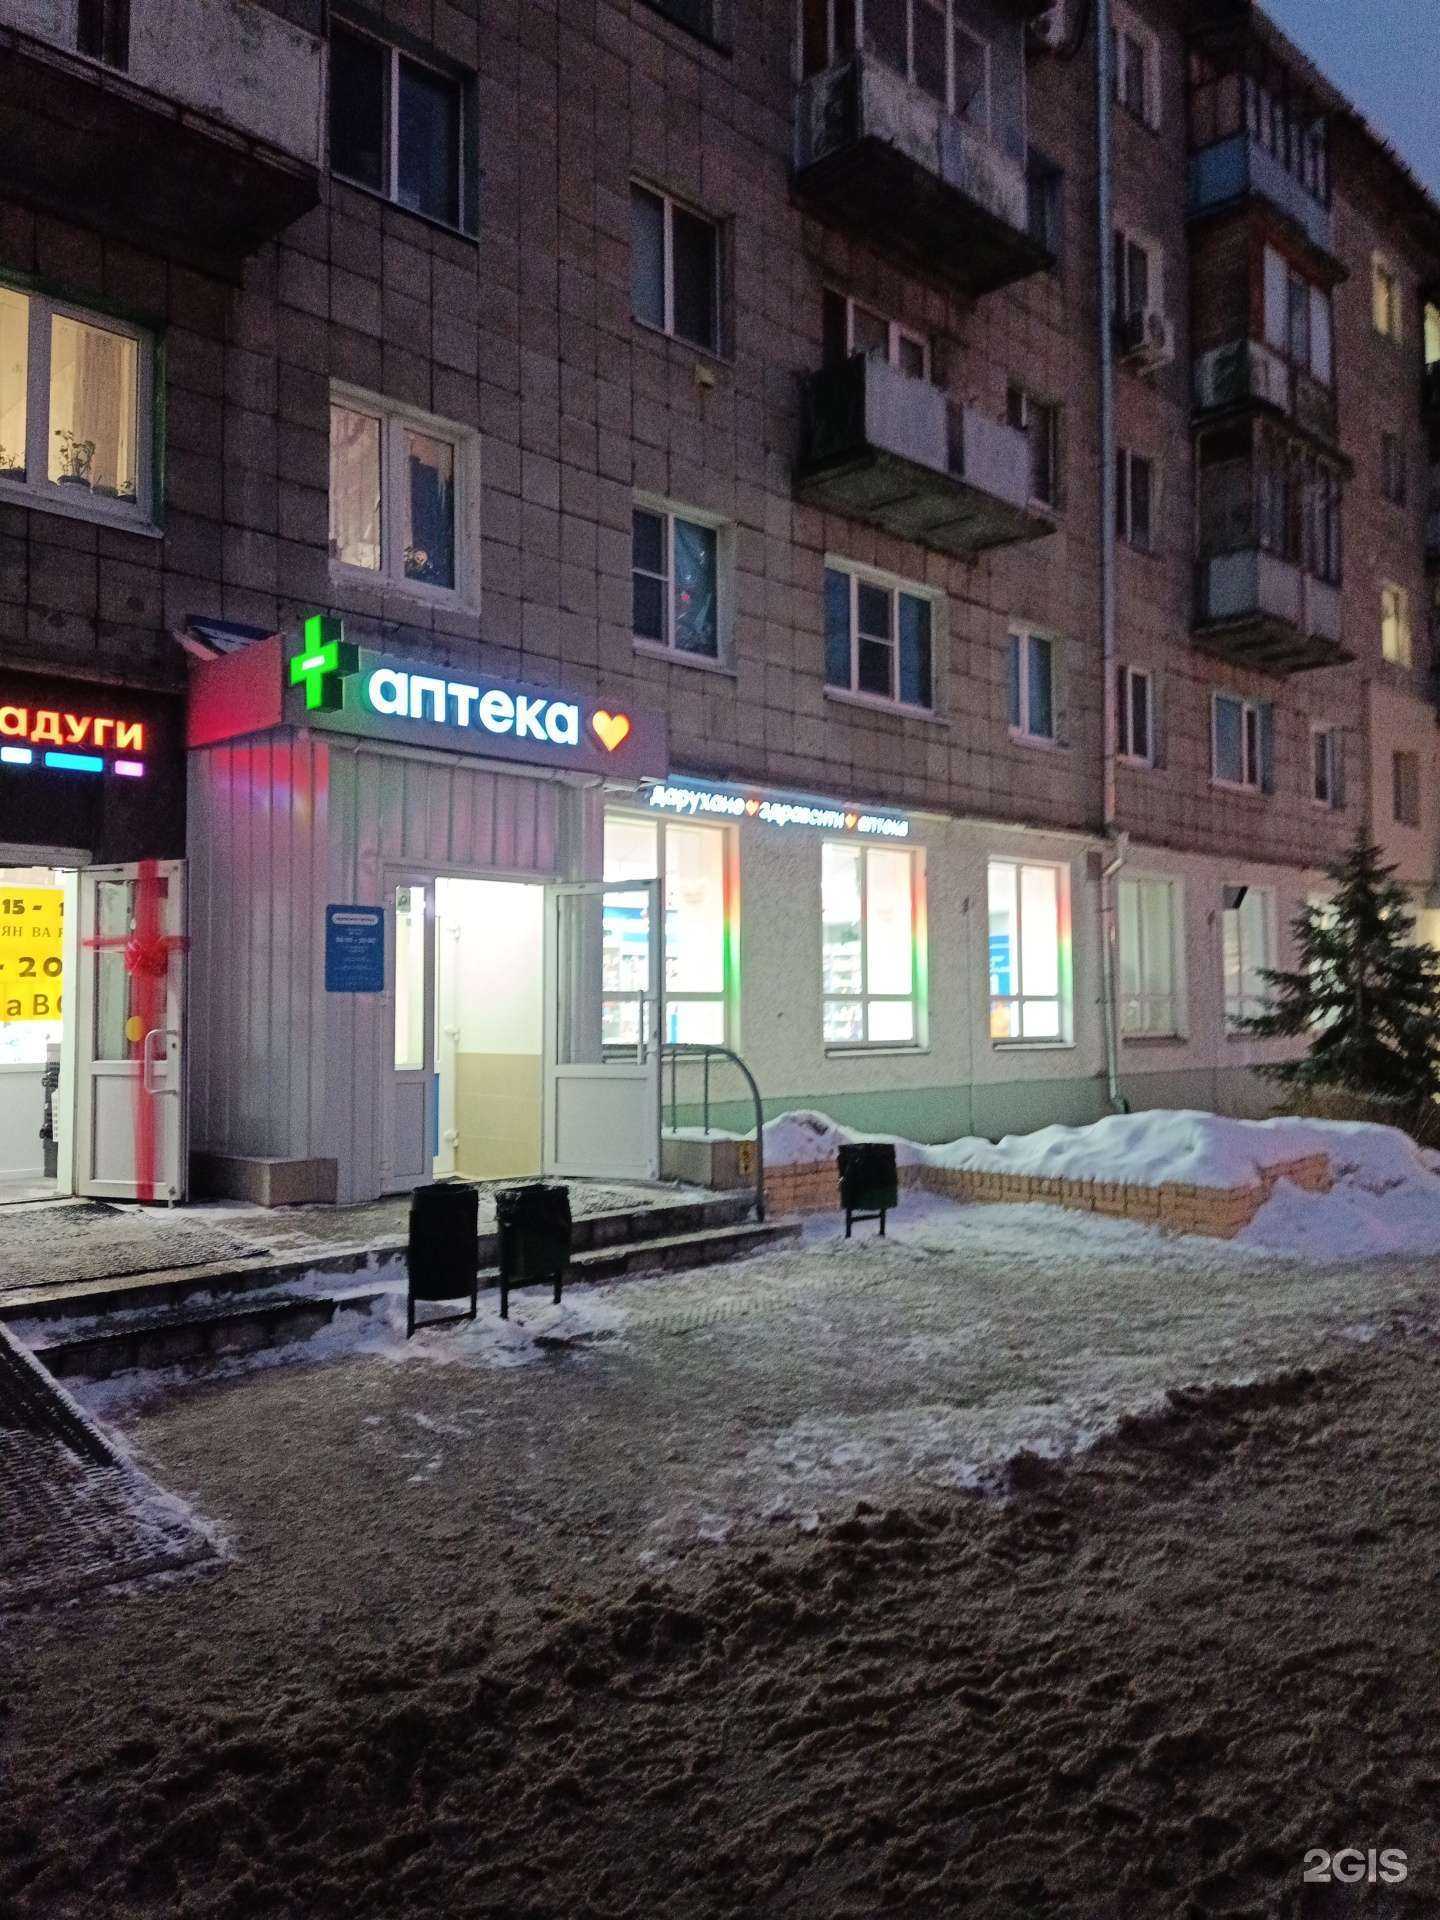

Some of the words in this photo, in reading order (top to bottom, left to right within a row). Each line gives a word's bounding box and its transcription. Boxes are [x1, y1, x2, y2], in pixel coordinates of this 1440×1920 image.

[0, 706, 143, 750] адуги
[368, 668, 578, 745] аптека
[2, 899, 25, 915] 15
